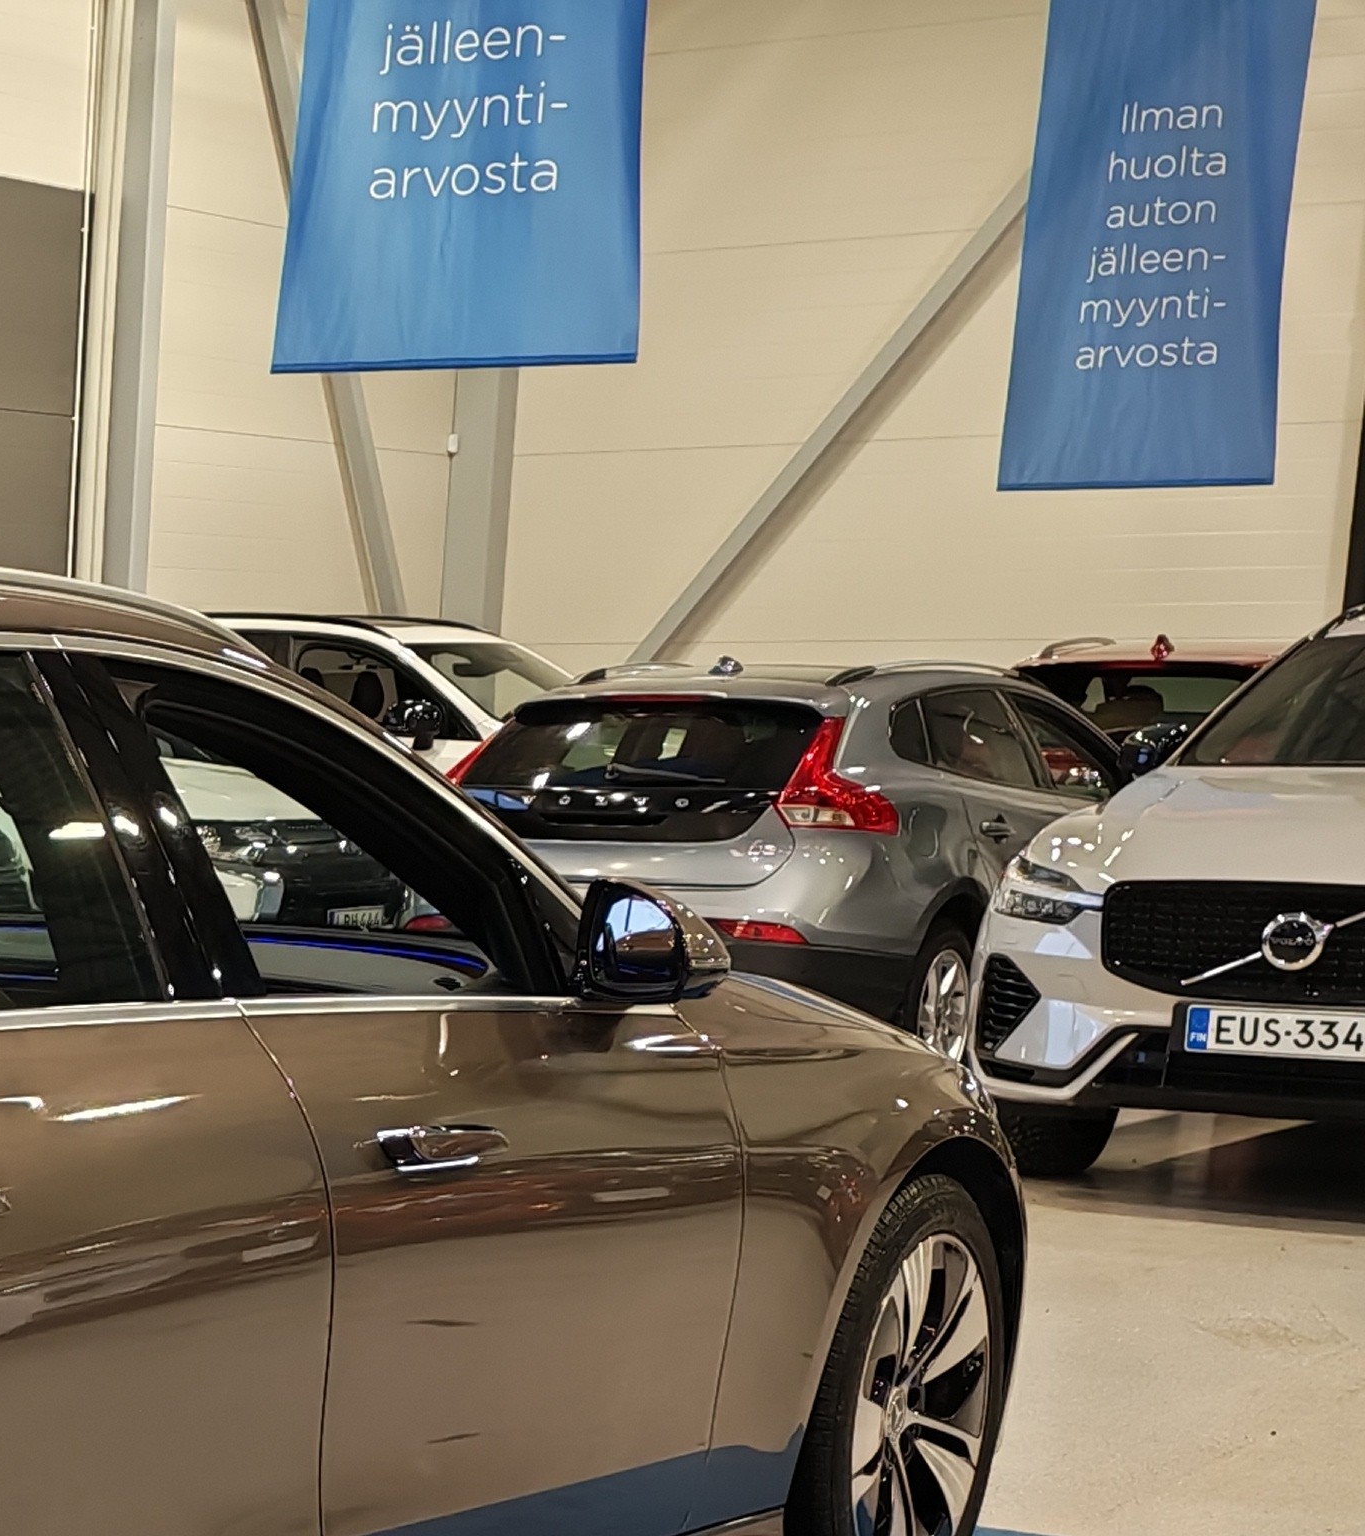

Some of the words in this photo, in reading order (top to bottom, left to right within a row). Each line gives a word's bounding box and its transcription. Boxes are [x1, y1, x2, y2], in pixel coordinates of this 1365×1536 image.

[379, 20, 567, 75] jälleen-
[372, 81, 568, 140] myynti-
[1121, 101, 1224, 134] Ilman
[369, 152, 559, 199] arvosta
[1108, 145, 1228, 183] huolta
[1105, 196, 1217, 229] auton
[1086, 243, 1226, 282] jälleen-
[1079, 288, 1227, 327] myynti-
[1075, 337, 1218, 370] arvosta
[1189, 1032, 1208, 1042] FIN
[1215, 1015, 1364, 1052] EUS-334
